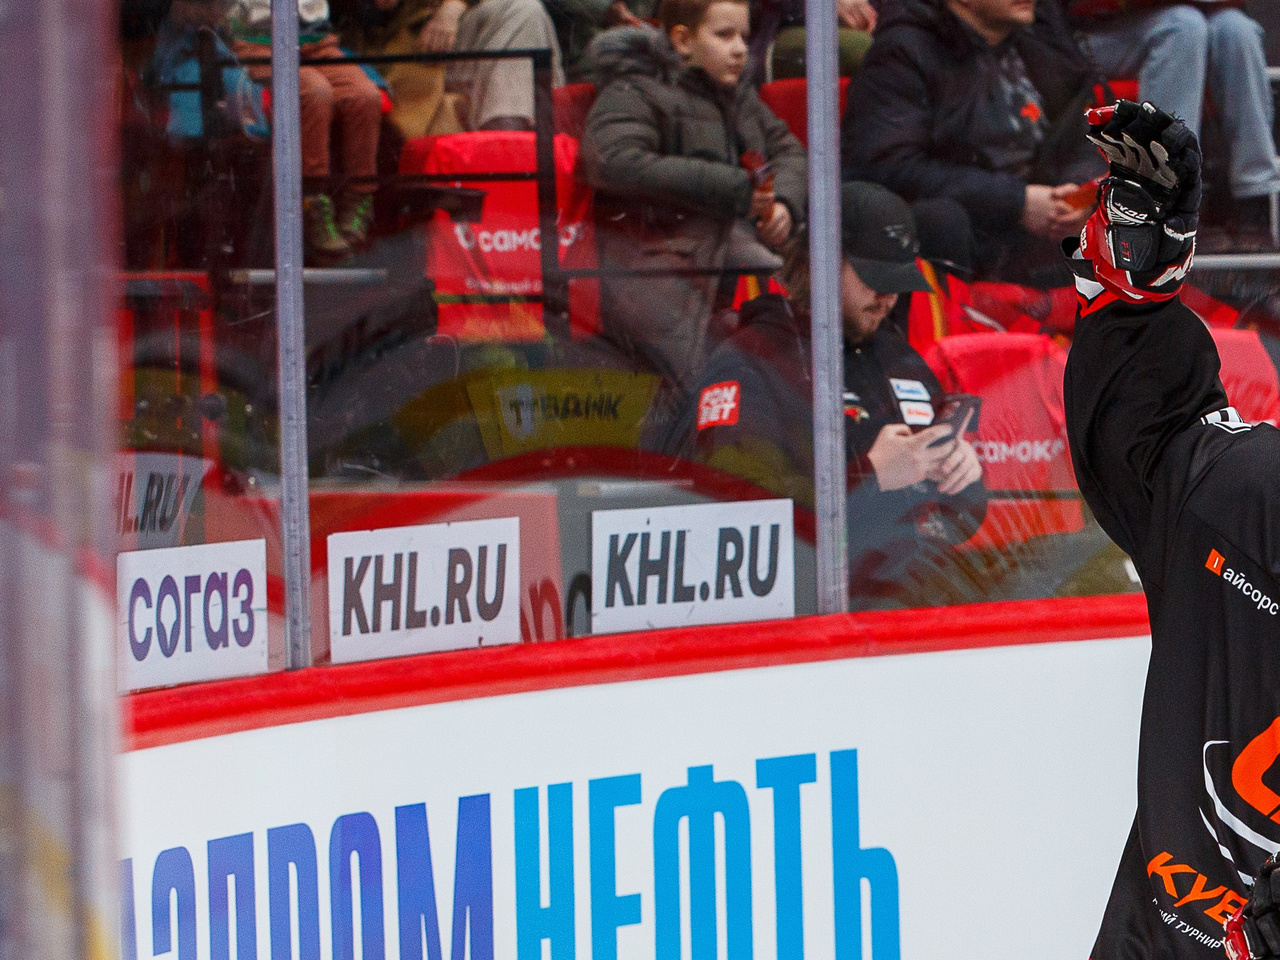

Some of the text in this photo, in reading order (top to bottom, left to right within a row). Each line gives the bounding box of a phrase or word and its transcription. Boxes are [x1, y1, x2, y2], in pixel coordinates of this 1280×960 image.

[342, 543, 507, 637] KHL.RU
[604, 524, 781, 608] KHL.RU
[1223, 567, 1279, 615] айсорс
[1175, 920, 1221, 949] ТУРНИР
